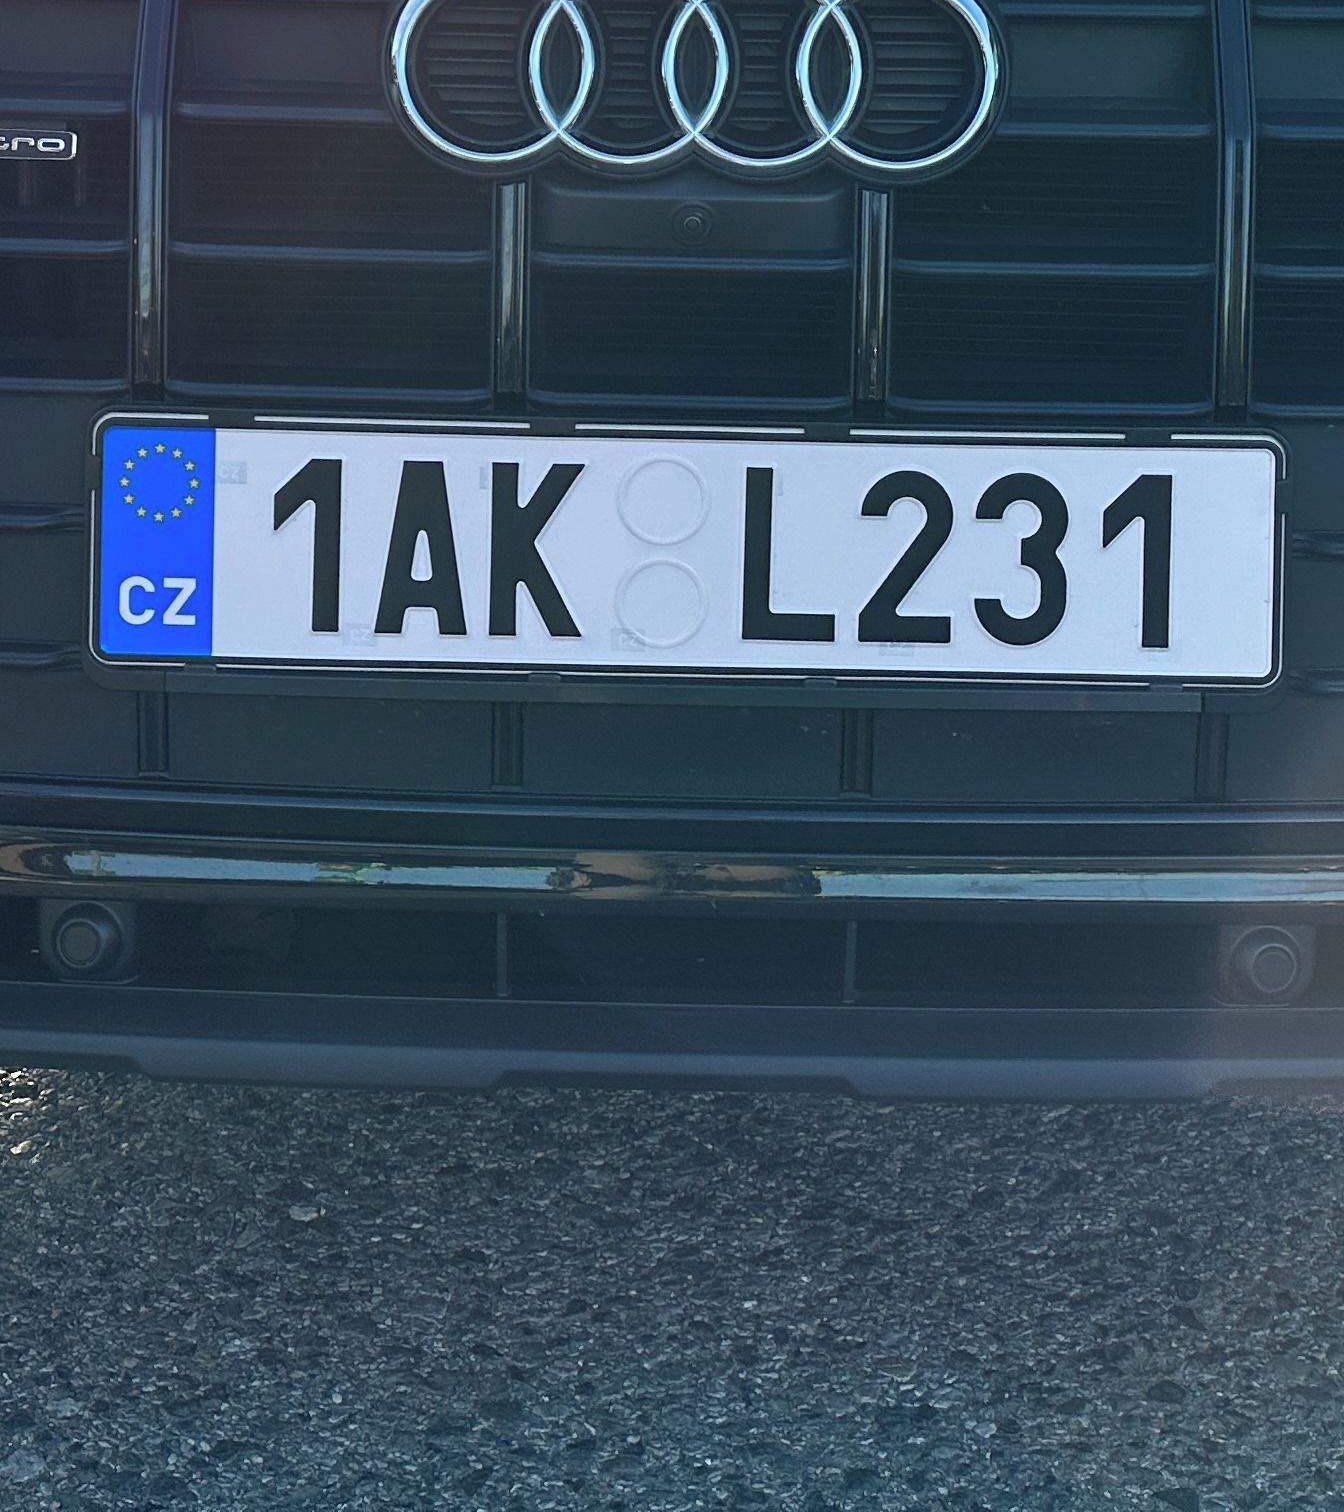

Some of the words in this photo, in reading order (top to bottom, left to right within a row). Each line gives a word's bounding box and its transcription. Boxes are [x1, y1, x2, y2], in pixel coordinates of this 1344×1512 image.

[119, 575, 197, 626] CZ
[273, 458, 586, 637] 1AK
[741, 467, 1173, 648] L231
